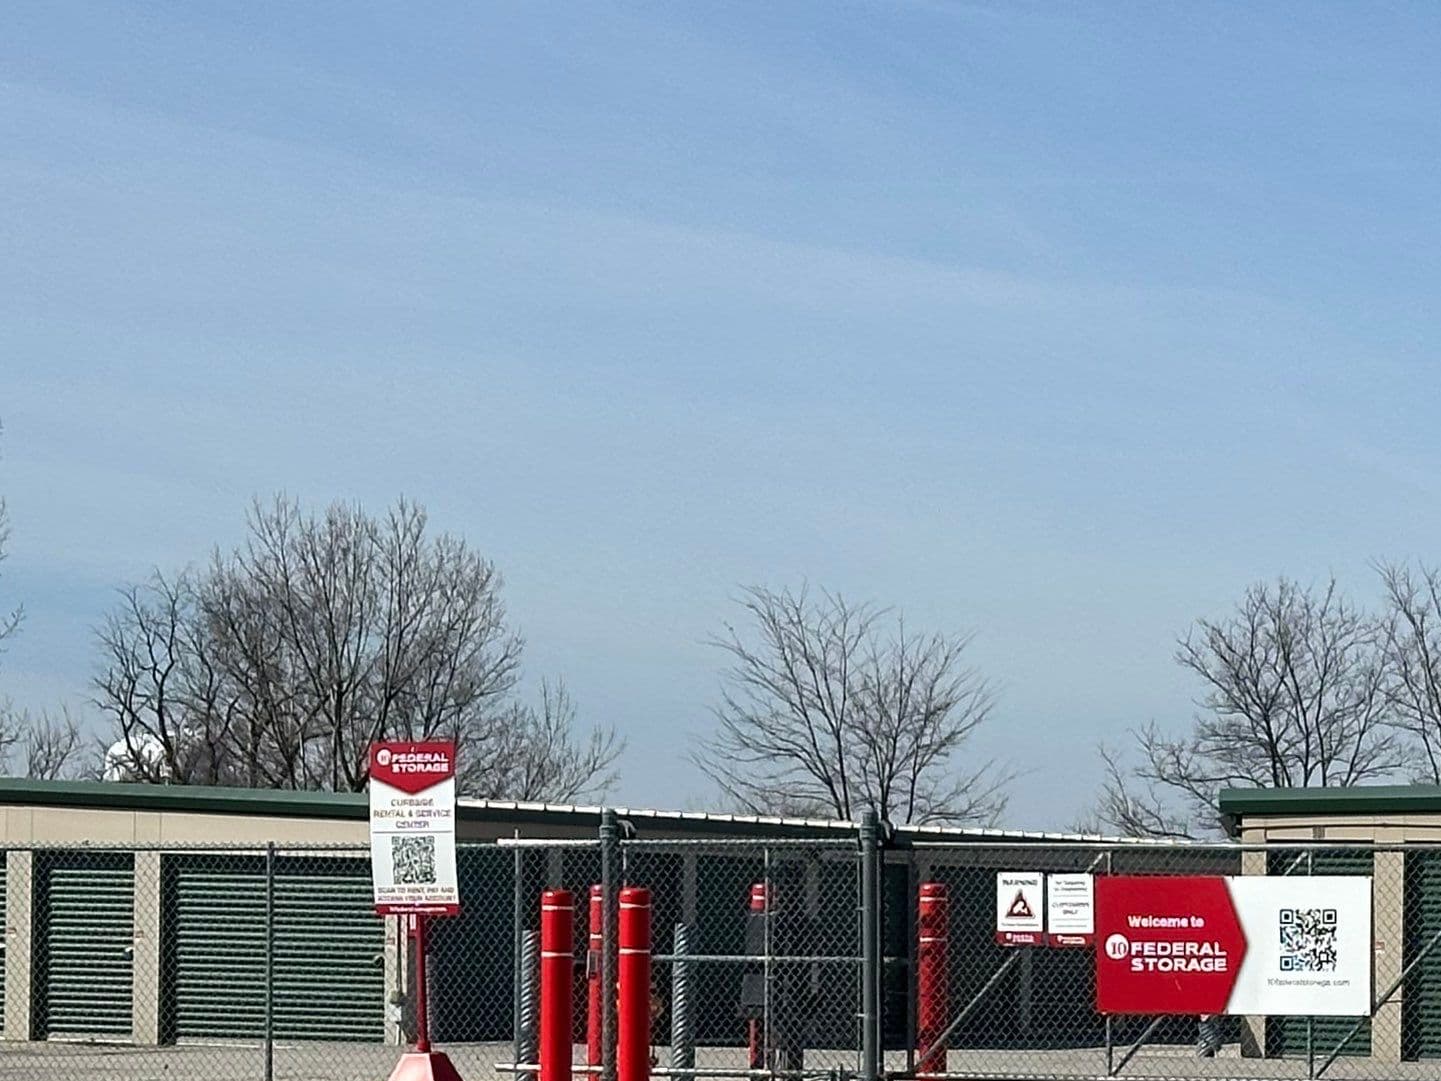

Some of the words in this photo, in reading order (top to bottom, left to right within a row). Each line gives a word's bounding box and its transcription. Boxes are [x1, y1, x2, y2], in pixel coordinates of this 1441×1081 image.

[391, 752, 449, 763] FEDERAL
[391, 763, 449, 773] STORAGE
[373, 810, 405, 818] RENTAL
[415, 810, 451, 818] SERVICE
[1127, 915, 1189, 928] Welcome
[1190, 915, 1205, 928] to
[1111, 942, 1127, 955] 10
[1130, 941, 1227, 956] FEDERAL
[1130, 957, 1228, 972] STORAGE
